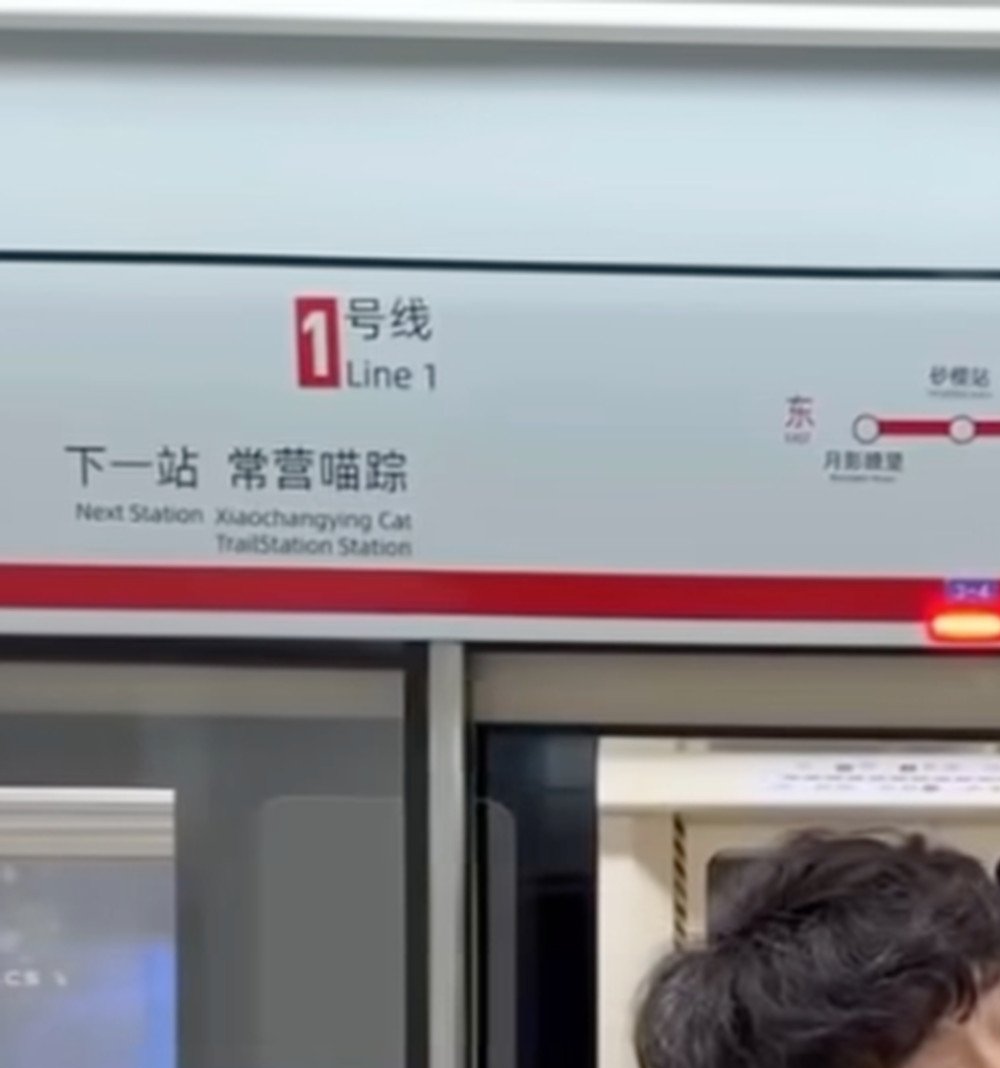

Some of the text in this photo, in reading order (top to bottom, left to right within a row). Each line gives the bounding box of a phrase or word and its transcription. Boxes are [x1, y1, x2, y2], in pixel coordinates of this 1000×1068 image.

[302, 298, 432, 377] 1 号线
[347, 360, 436, 390] Line 1
[785, 395, 815, 429] 东
[64, 446, 408, 492] 下一站 常营喵踪
[76, 503, 204, 524] Next Station
[215, 508, 412, 533] Xiaochangying Cat
[338, 536, 412, 556] Station
